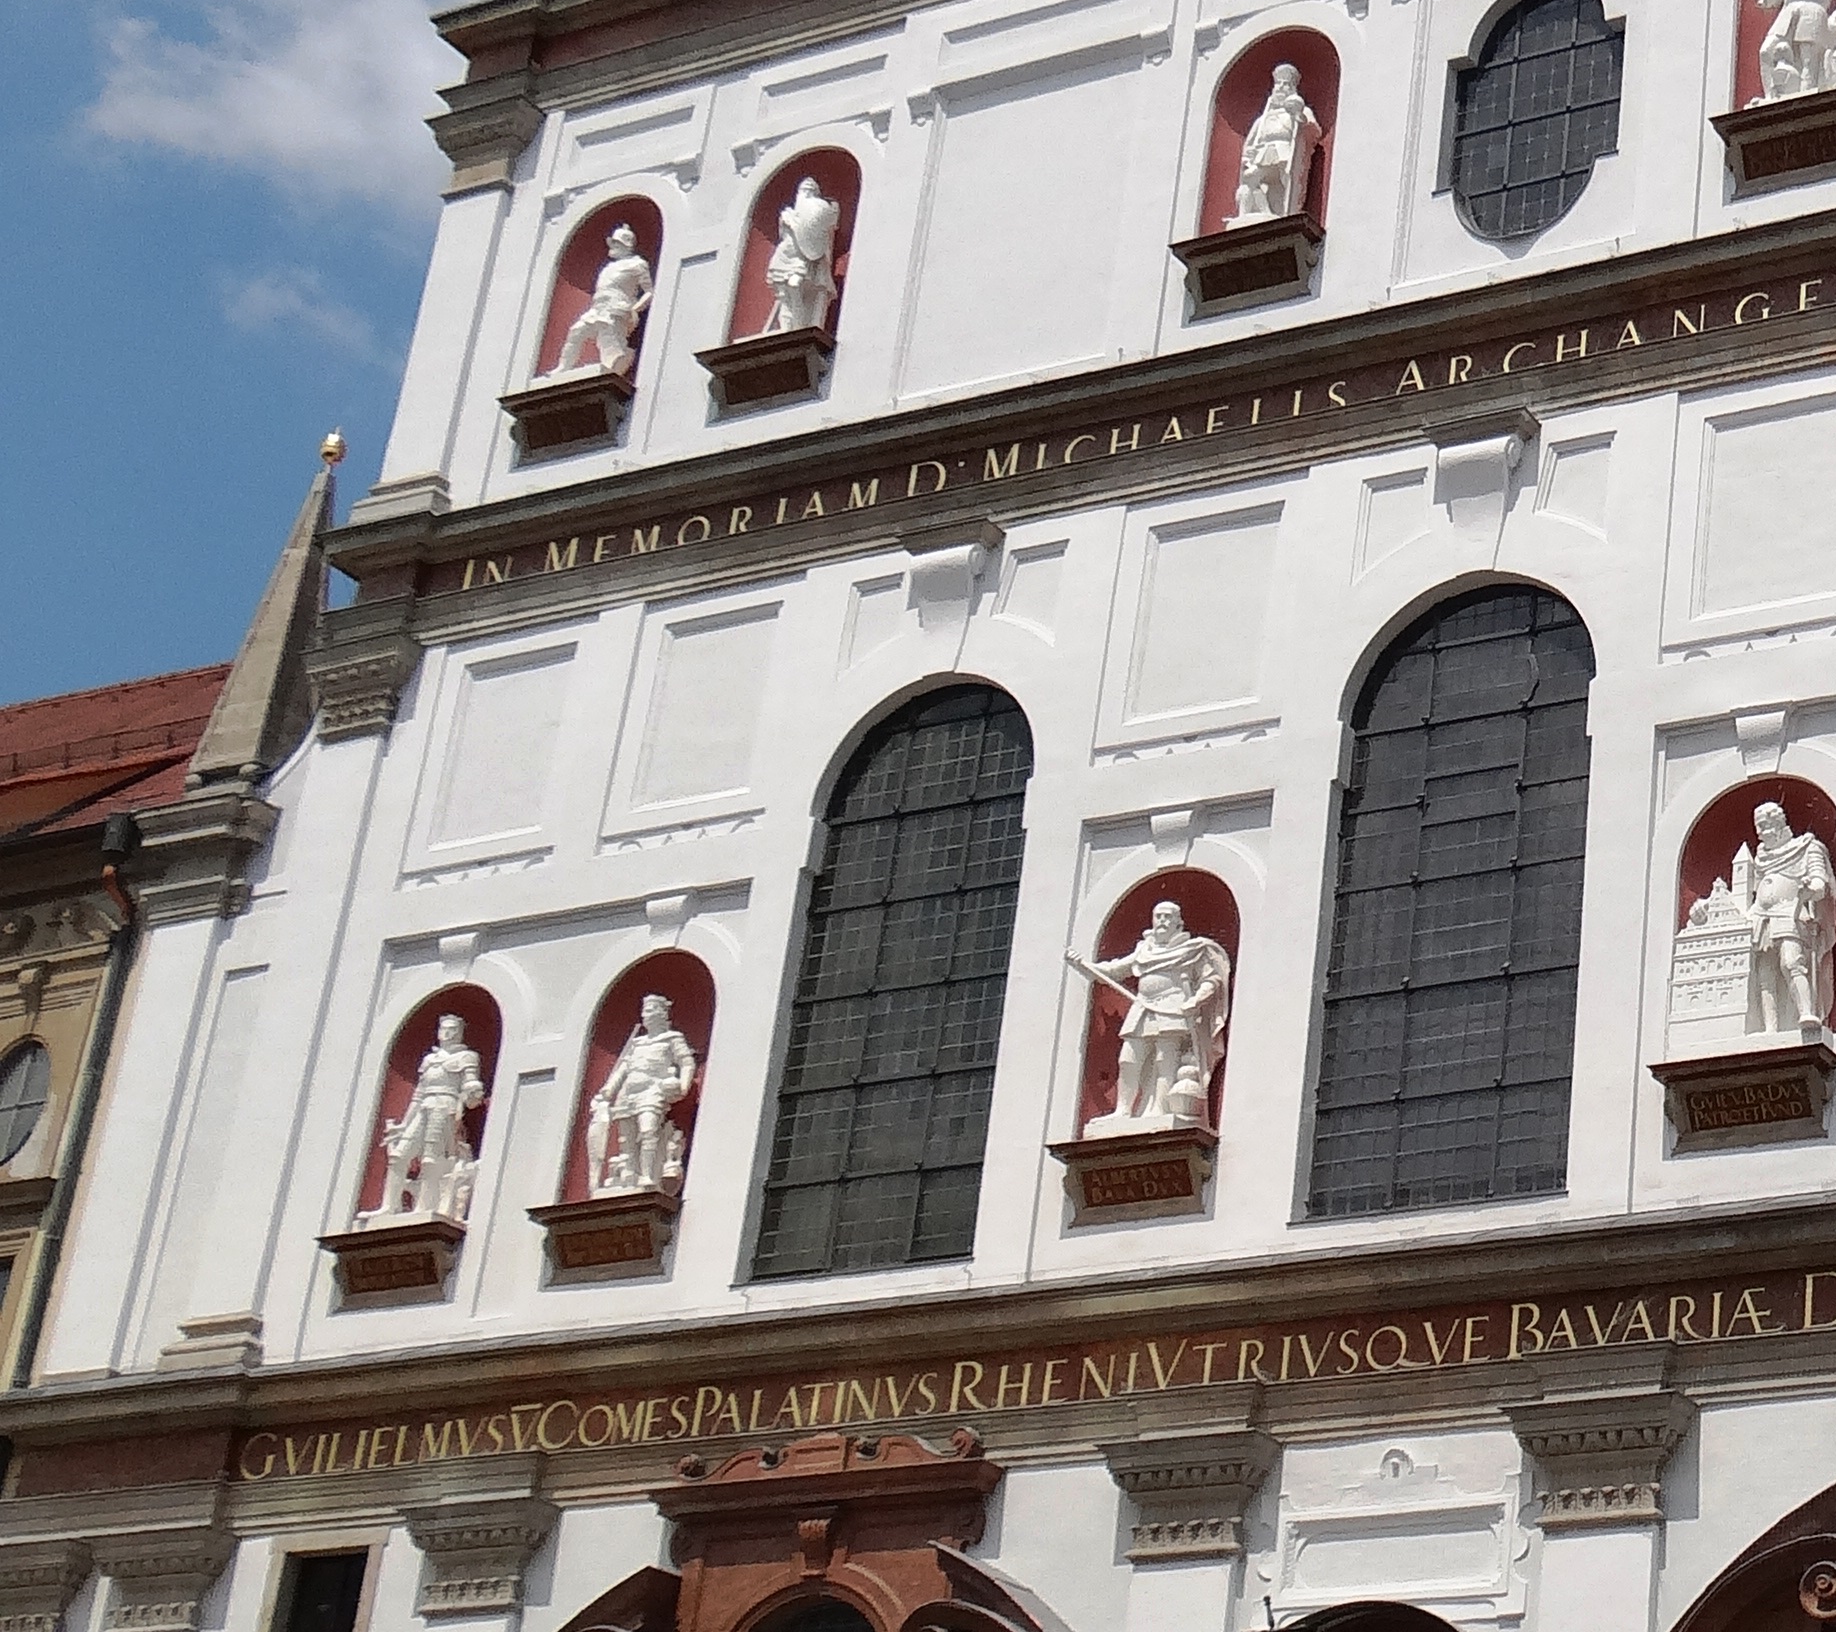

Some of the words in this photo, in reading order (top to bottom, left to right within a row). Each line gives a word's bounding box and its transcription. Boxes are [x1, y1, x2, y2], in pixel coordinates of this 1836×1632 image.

[462, 554, 514, 591] IN
[543, 477, 880, 573] MEMORIAM
[982, 380, 1347, 482] MICHAELIS
[239, 1413, 508, 1480] GVILIELMVS
[535, 1395, 690, 1450] COMES
[690, 1371, 938, 1437] PALATINVS
[949, 1351, 1140, 1413] RHENI
[1146, 1315, 1491, 1391] VTRIVSQVE
